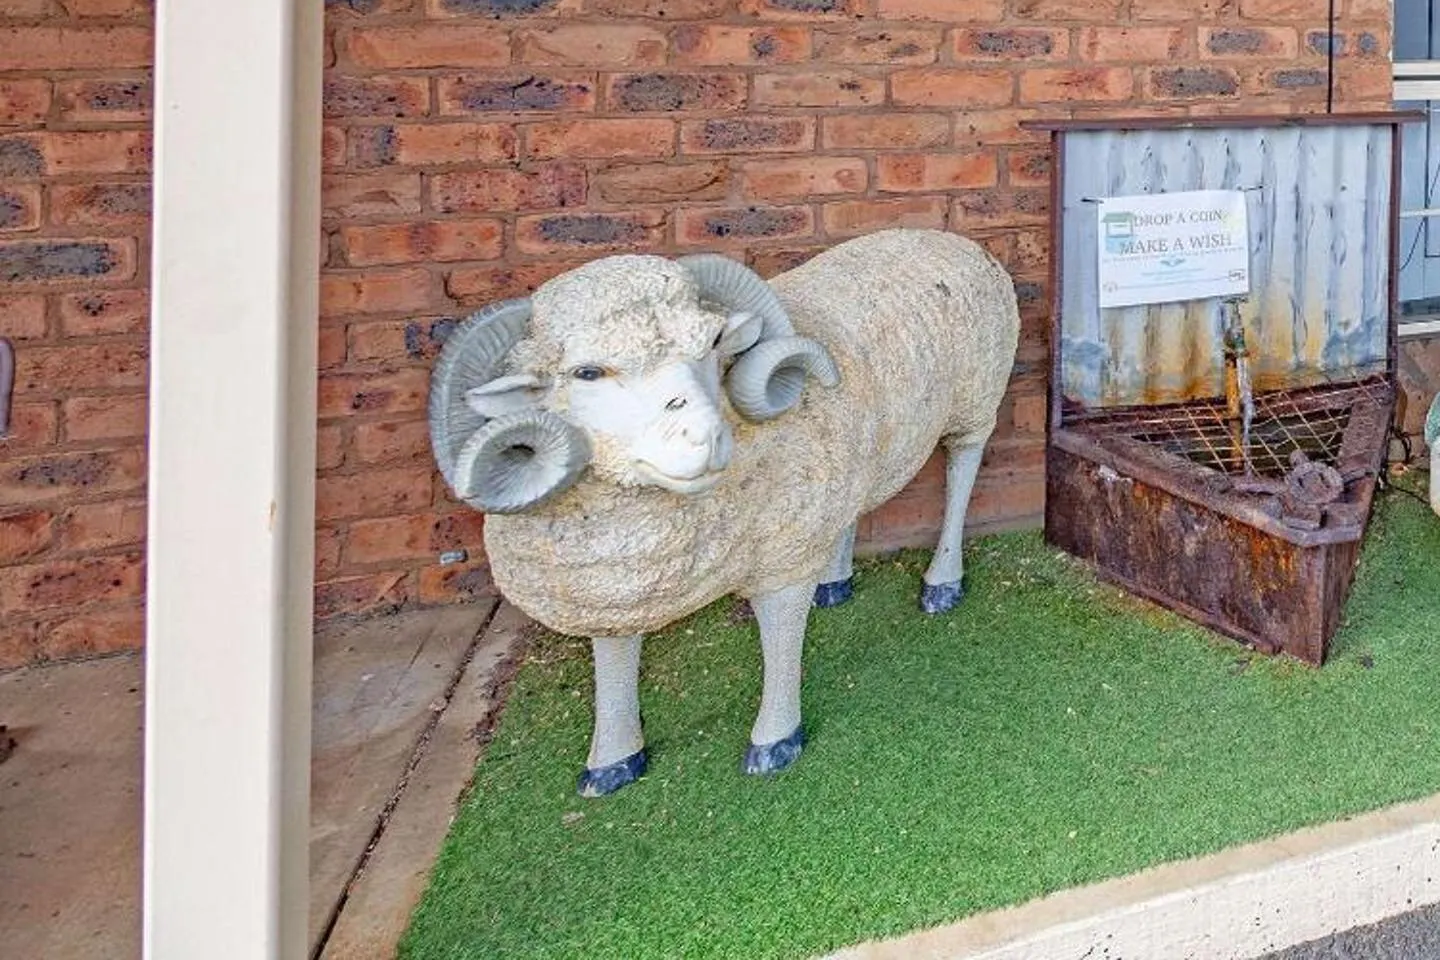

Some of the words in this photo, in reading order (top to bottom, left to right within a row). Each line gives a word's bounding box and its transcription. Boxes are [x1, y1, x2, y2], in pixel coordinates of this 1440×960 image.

[1134, 213, 1172, 228] DROP
[1175, 211, 1186, 224] A
[1120, 237, 1168, 255] MAKE
[1173, 238, 1184, 251] A
[1190, 233, 1232, 249] WISH
